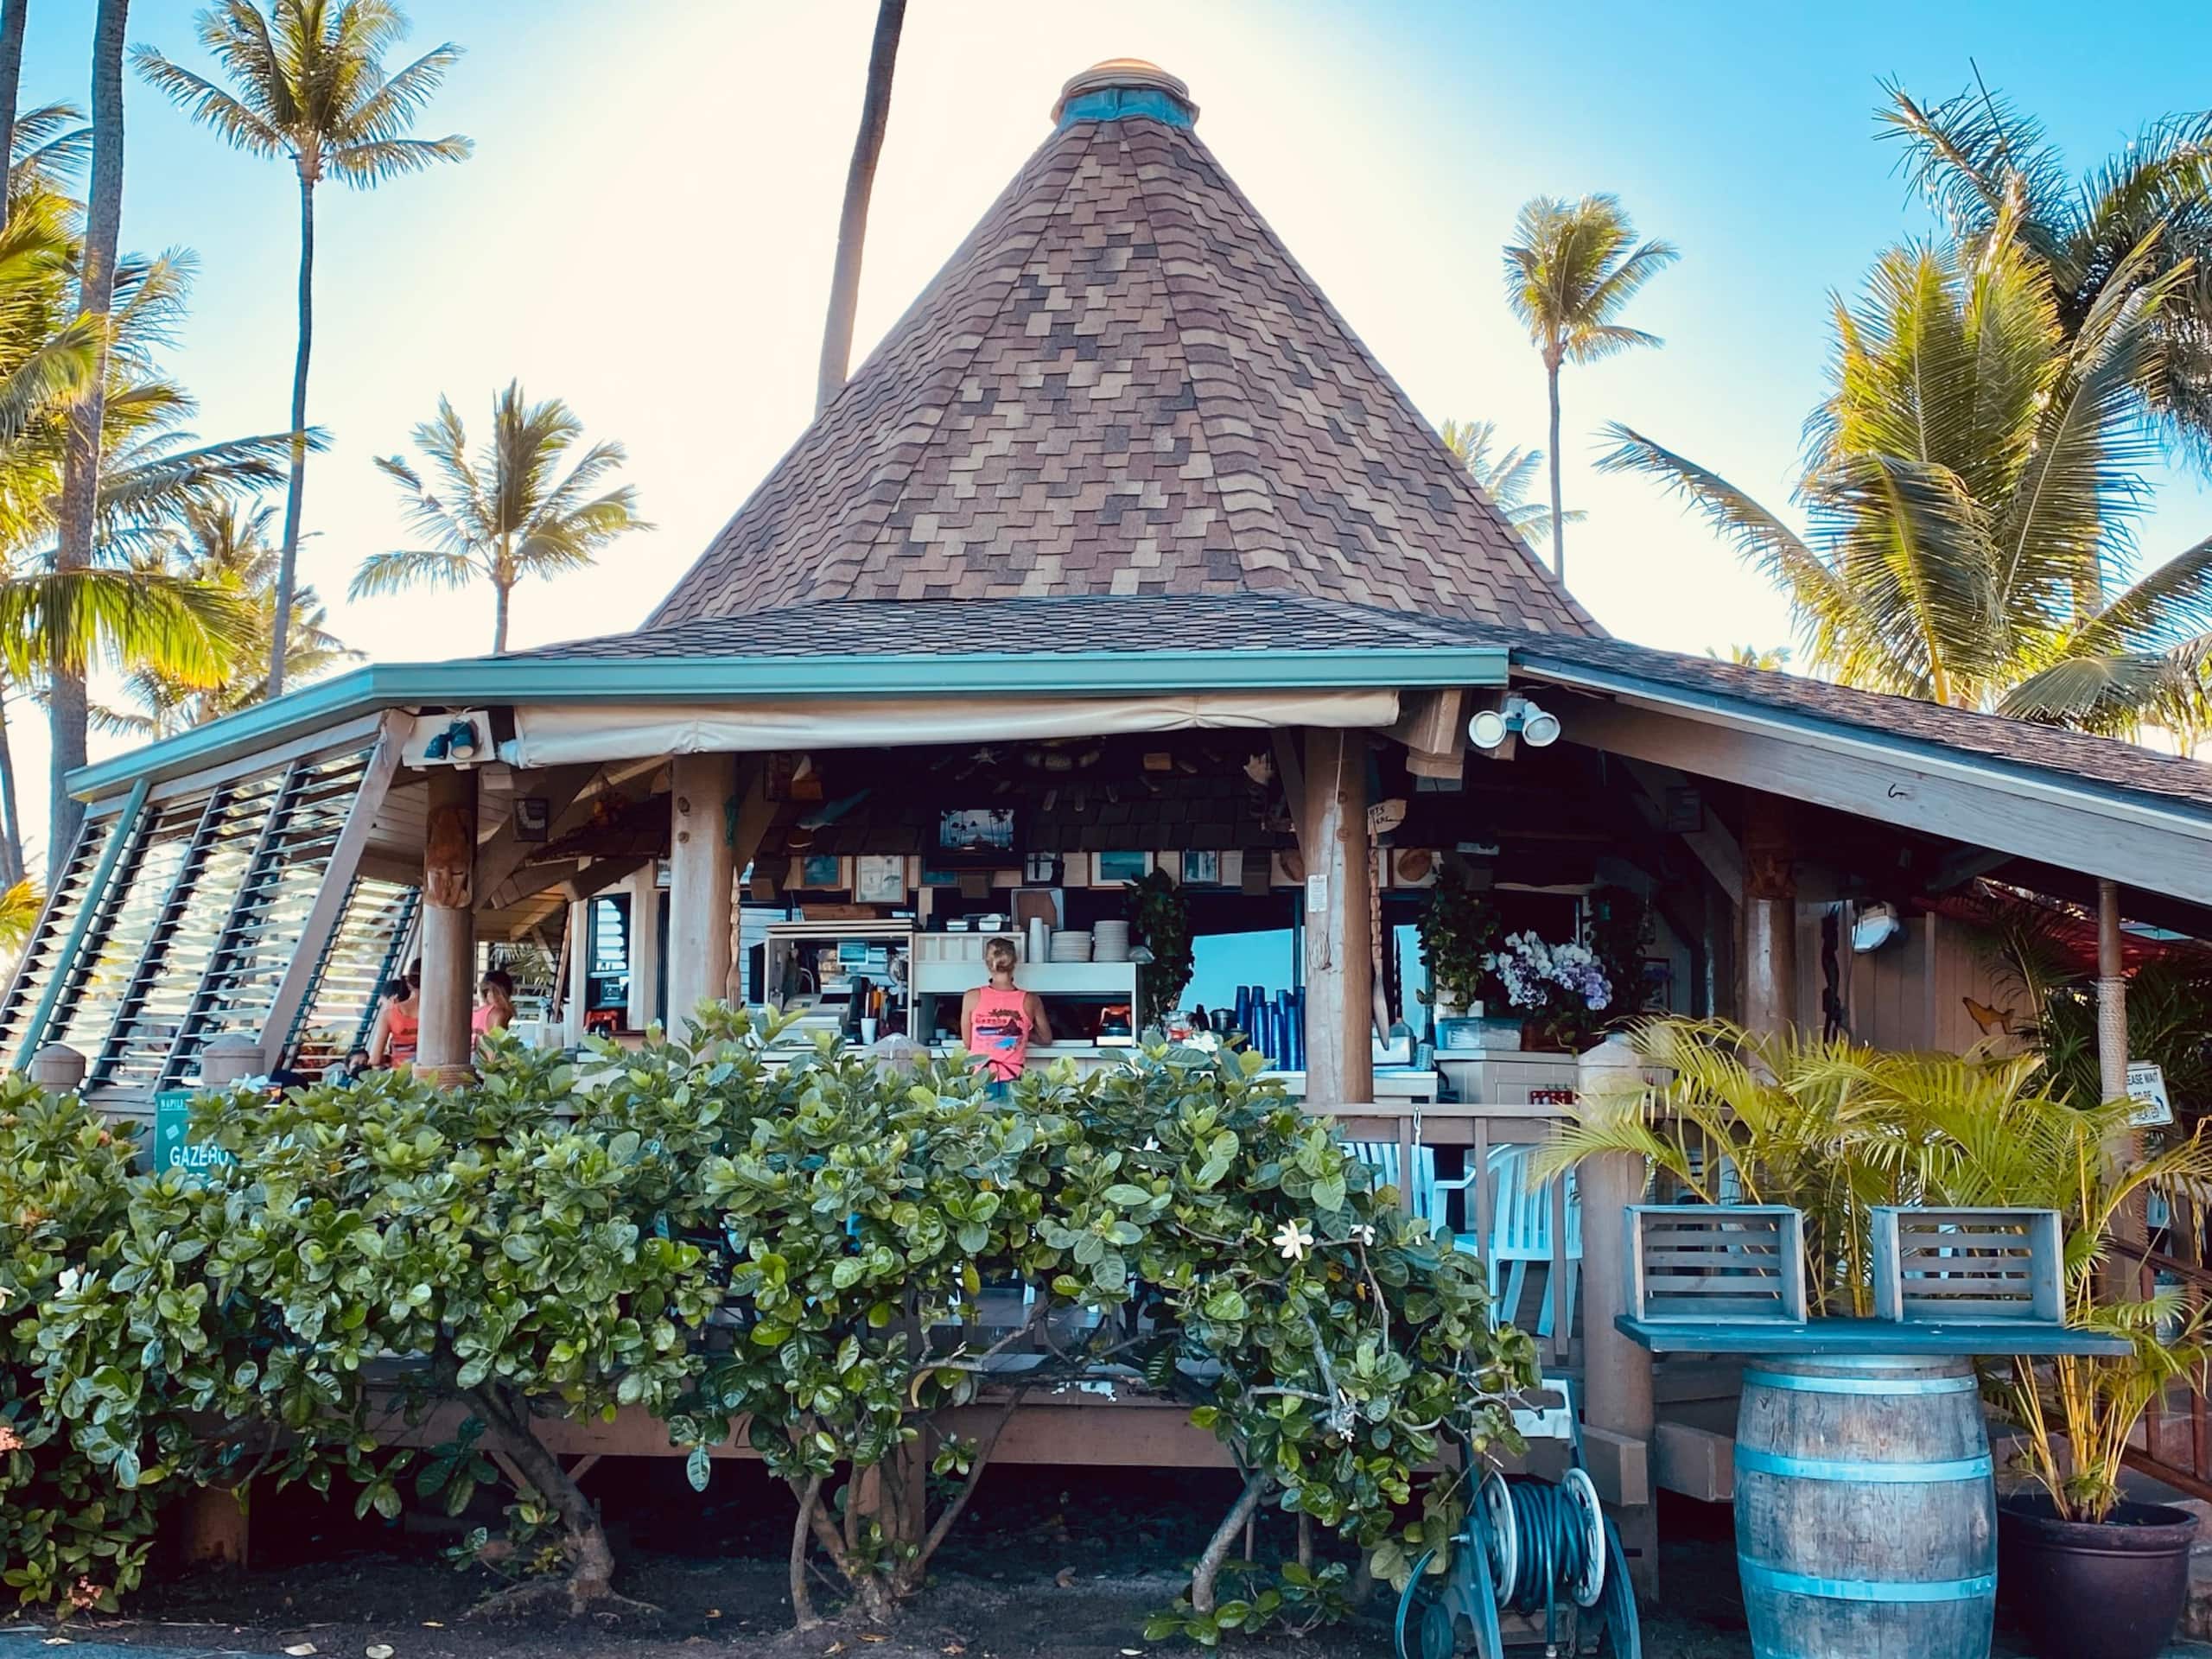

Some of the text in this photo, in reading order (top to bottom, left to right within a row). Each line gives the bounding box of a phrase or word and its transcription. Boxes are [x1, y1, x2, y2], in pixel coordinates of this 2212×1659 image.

[2126, 1071, 2158, 1085] EASE WAIT
[2133, 1091, 2141, 1100] TO
